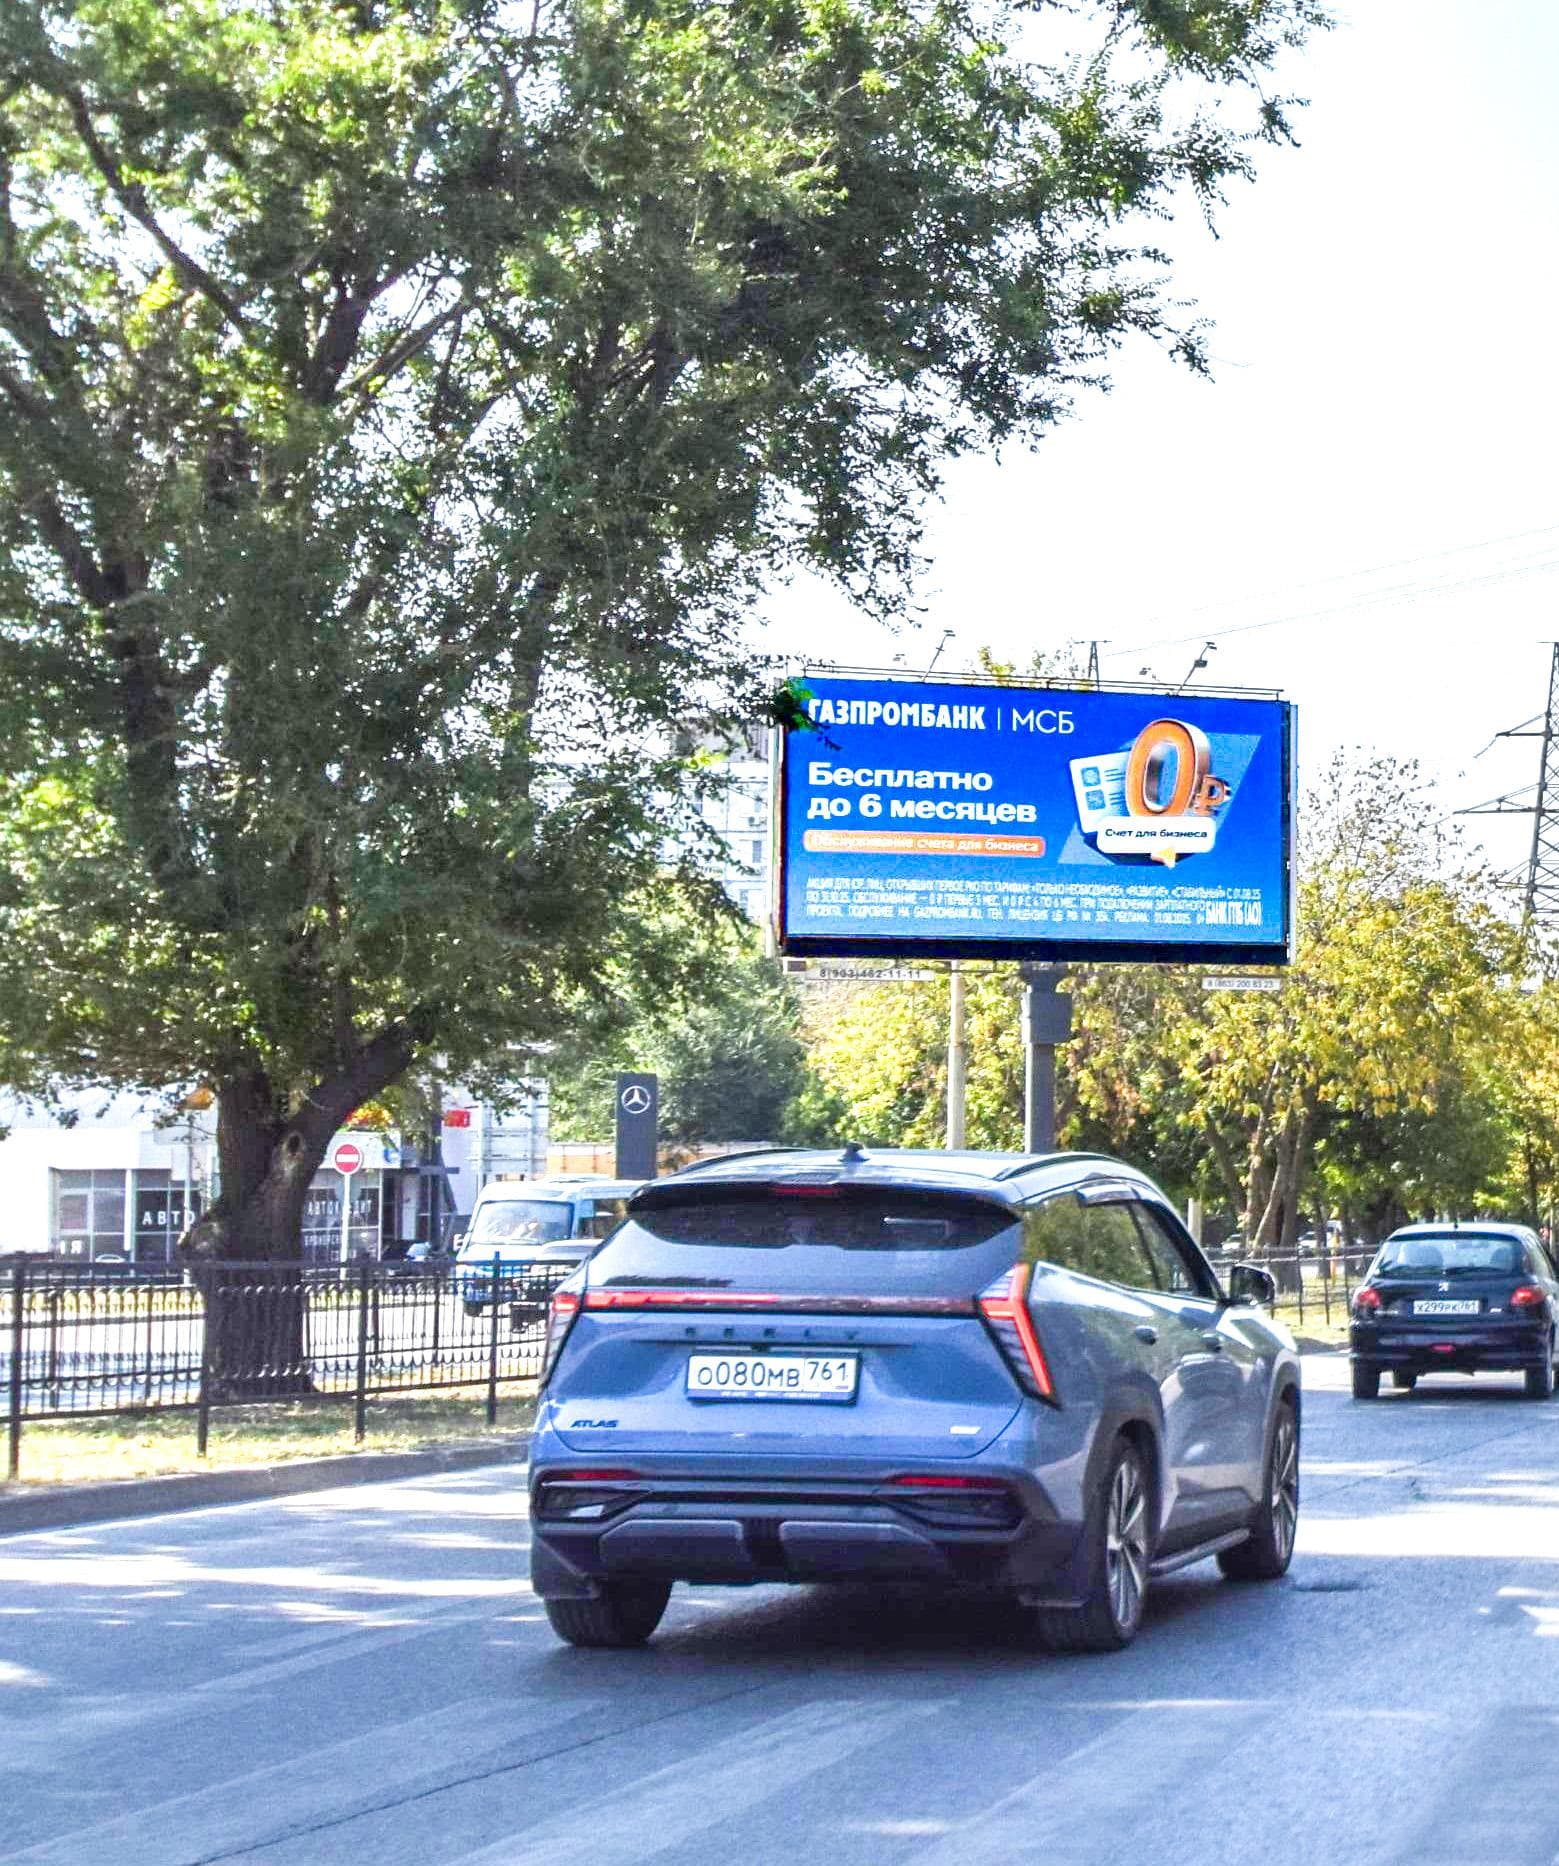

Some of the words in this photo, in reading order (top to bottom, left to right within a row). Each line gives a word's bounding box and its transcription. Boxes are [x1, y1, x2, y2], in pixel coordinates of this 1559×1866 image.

[808, 698, 986, 730] ГАЗПРОМБАНК
[1012, 708, 1074, 735] МСБ
[808, 761, 993, 791] Бесплатно
[806, 796, 851, 819] до
[859, 793, 883, 818] 6
[890, 799, 1038, 825] месяцев
[1104, 828, 1134, 838] Счет
[1135, 829, 1157, 839] для
[1159, 828, 1208, 839] бизнеса
[916, 839, 955, 850] счета
[956, 839, 982, 852] для
[984, 837, 1040, 852] бизнеса
[807, 1360, 848, 1381] 761
[570, 1419, 619, 1429] ATLAS
